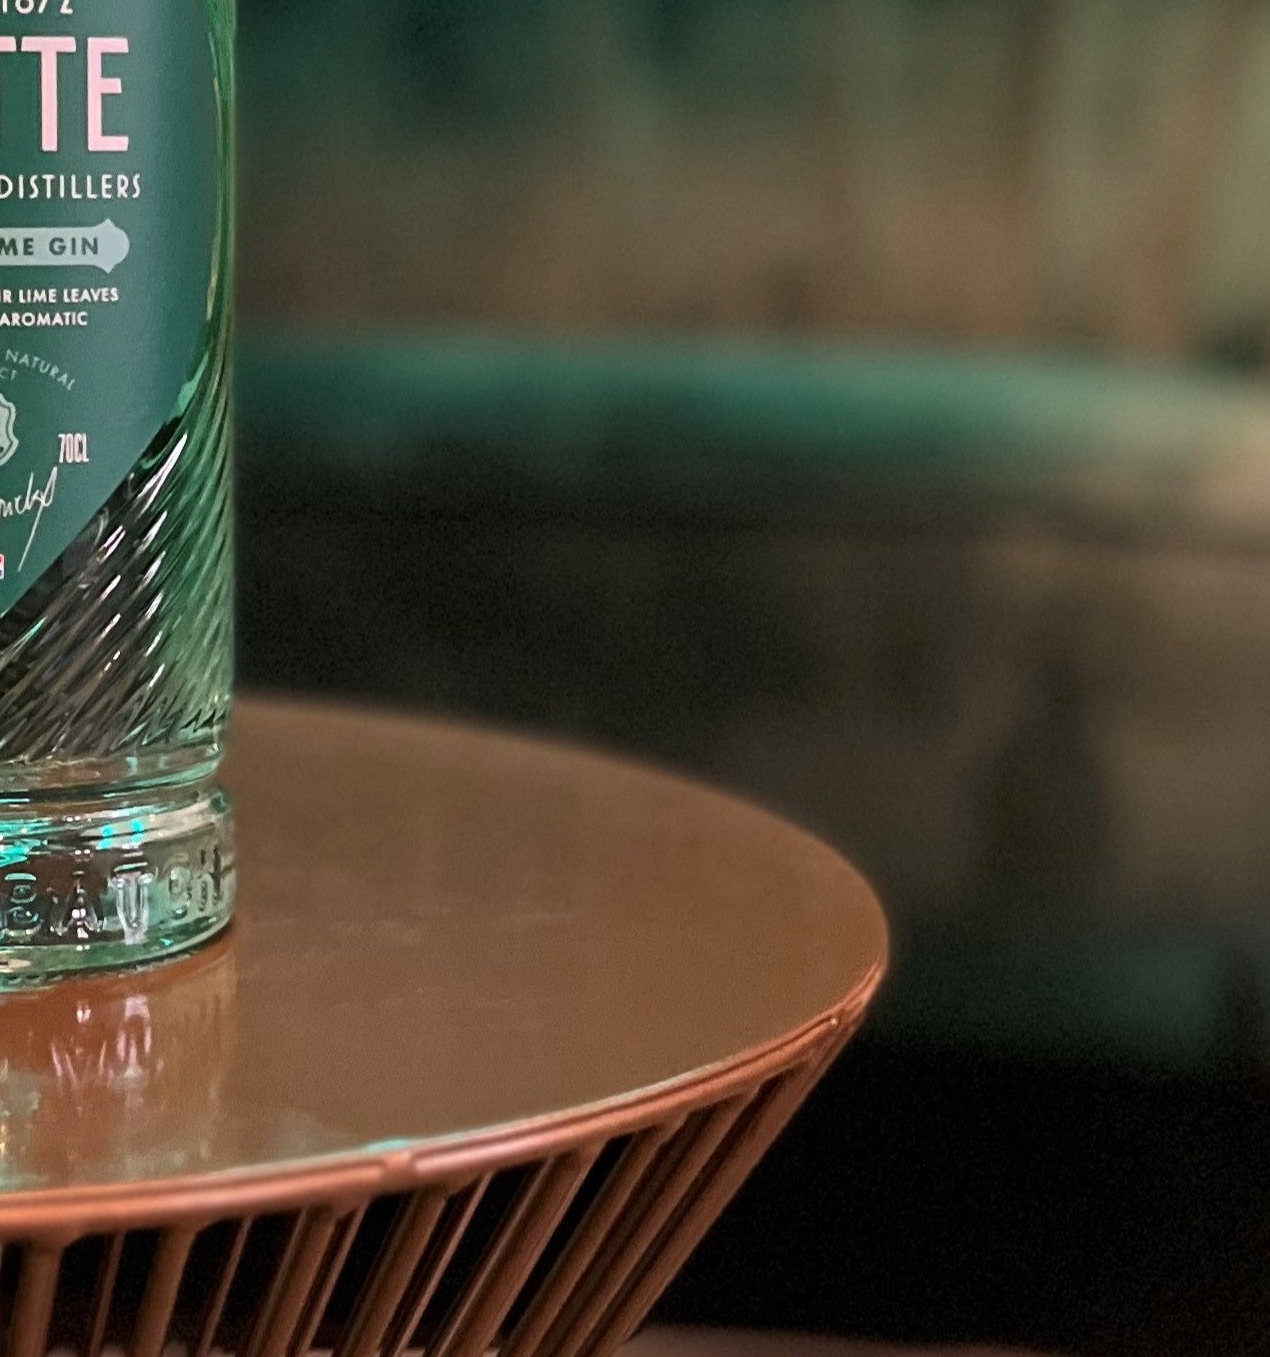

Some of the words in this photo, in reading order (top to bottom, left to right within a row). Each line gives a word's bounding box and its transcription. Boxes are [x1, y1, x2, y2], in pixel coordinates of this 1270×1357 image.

[48, 236, 100, 256] GIN
[18, 288, 58, 304] LIME
[62, 287, 120, 303] LEAVES
[5, 348, 76, 391] NATURAL
[58, 432, 90, 464] 70CL
